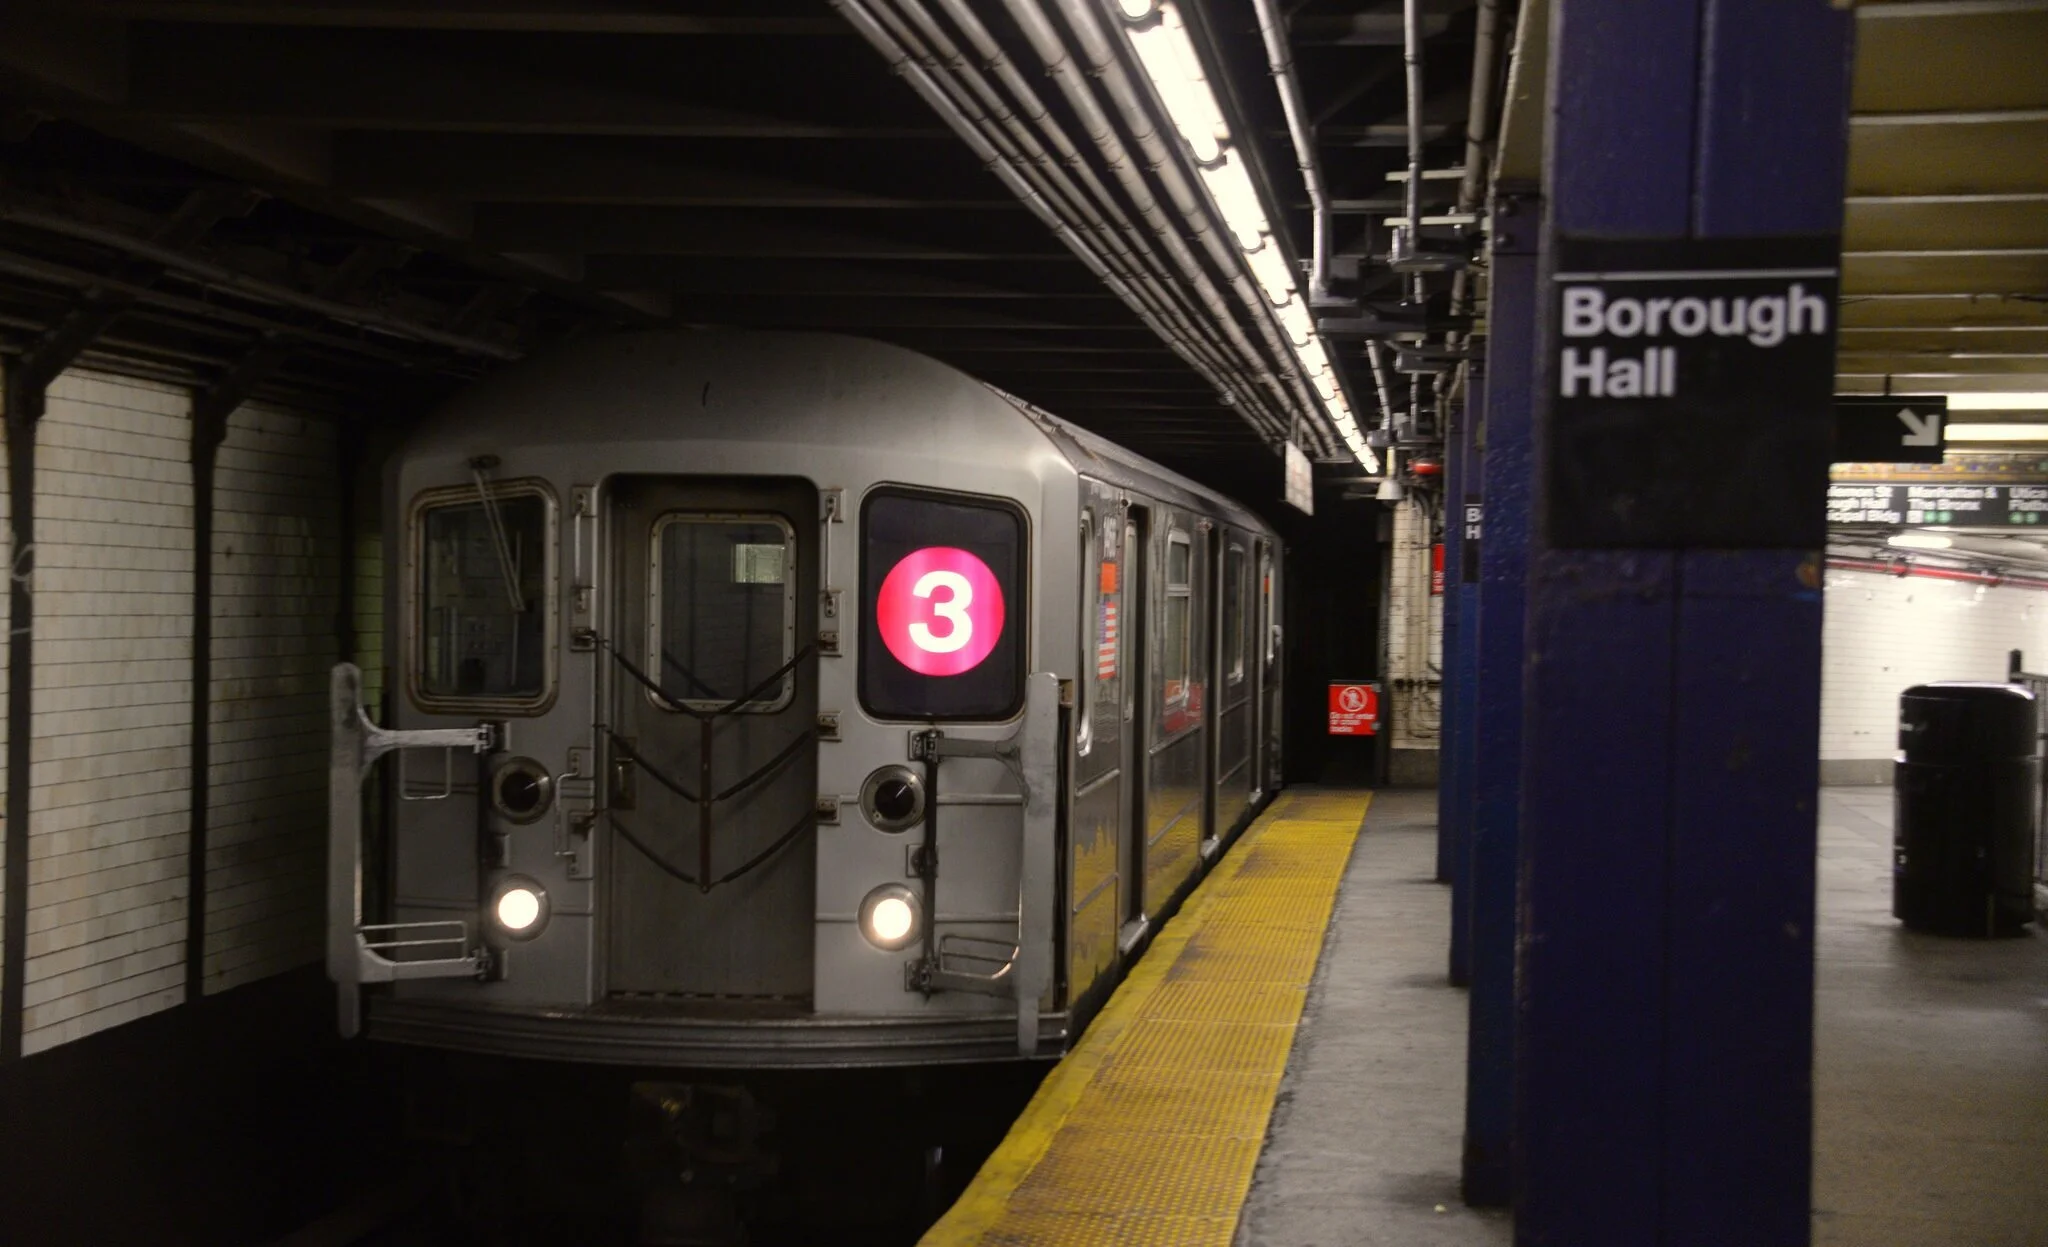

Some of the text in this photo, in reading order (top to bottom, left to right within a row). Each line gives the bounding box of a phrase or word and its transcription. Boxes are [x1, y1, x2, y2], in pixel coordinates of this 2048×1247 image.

[1562, 283, 1827, 347] Borough
[1560, 347, 1676, 397] Hall
[1907, 499, 1980, 510] The Bronx
[1908, 487, 1983, 498] Manhattan
[908, 570, 973, 653] 3
